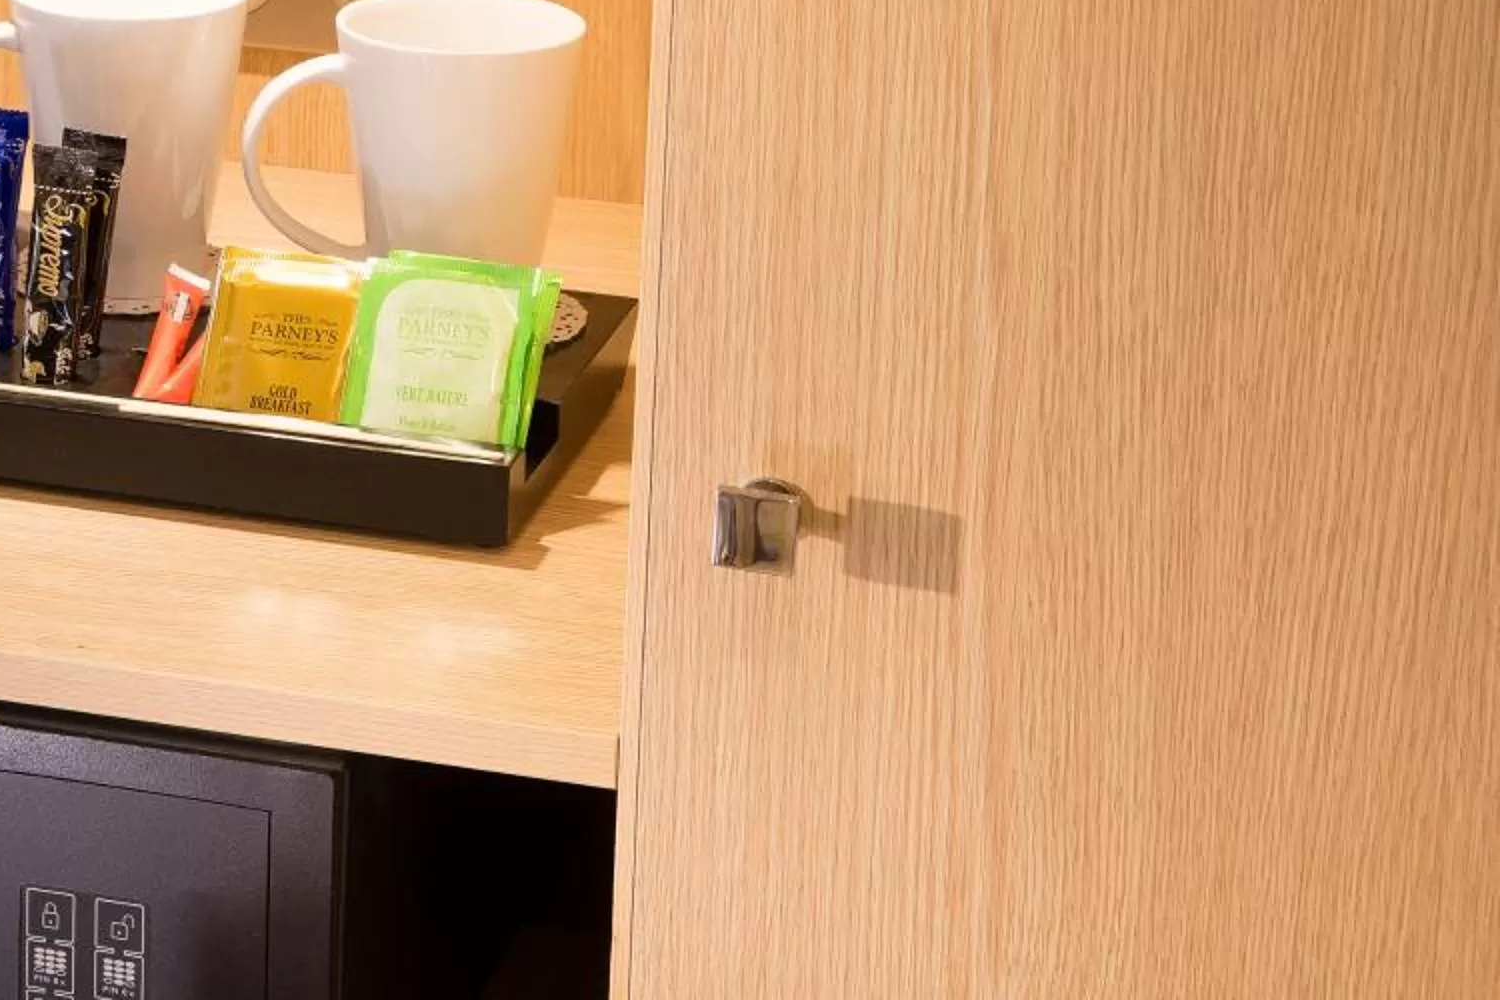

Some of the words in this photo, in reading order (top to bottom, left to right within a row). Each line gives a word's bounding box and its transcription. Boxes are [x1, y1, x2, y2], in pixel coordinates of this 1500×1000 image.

[37, 193, 87, 298] Supremo
[250, 320, 340, 345] PARNEY'S
[249, 395, 314, 417] BREAKFAST
